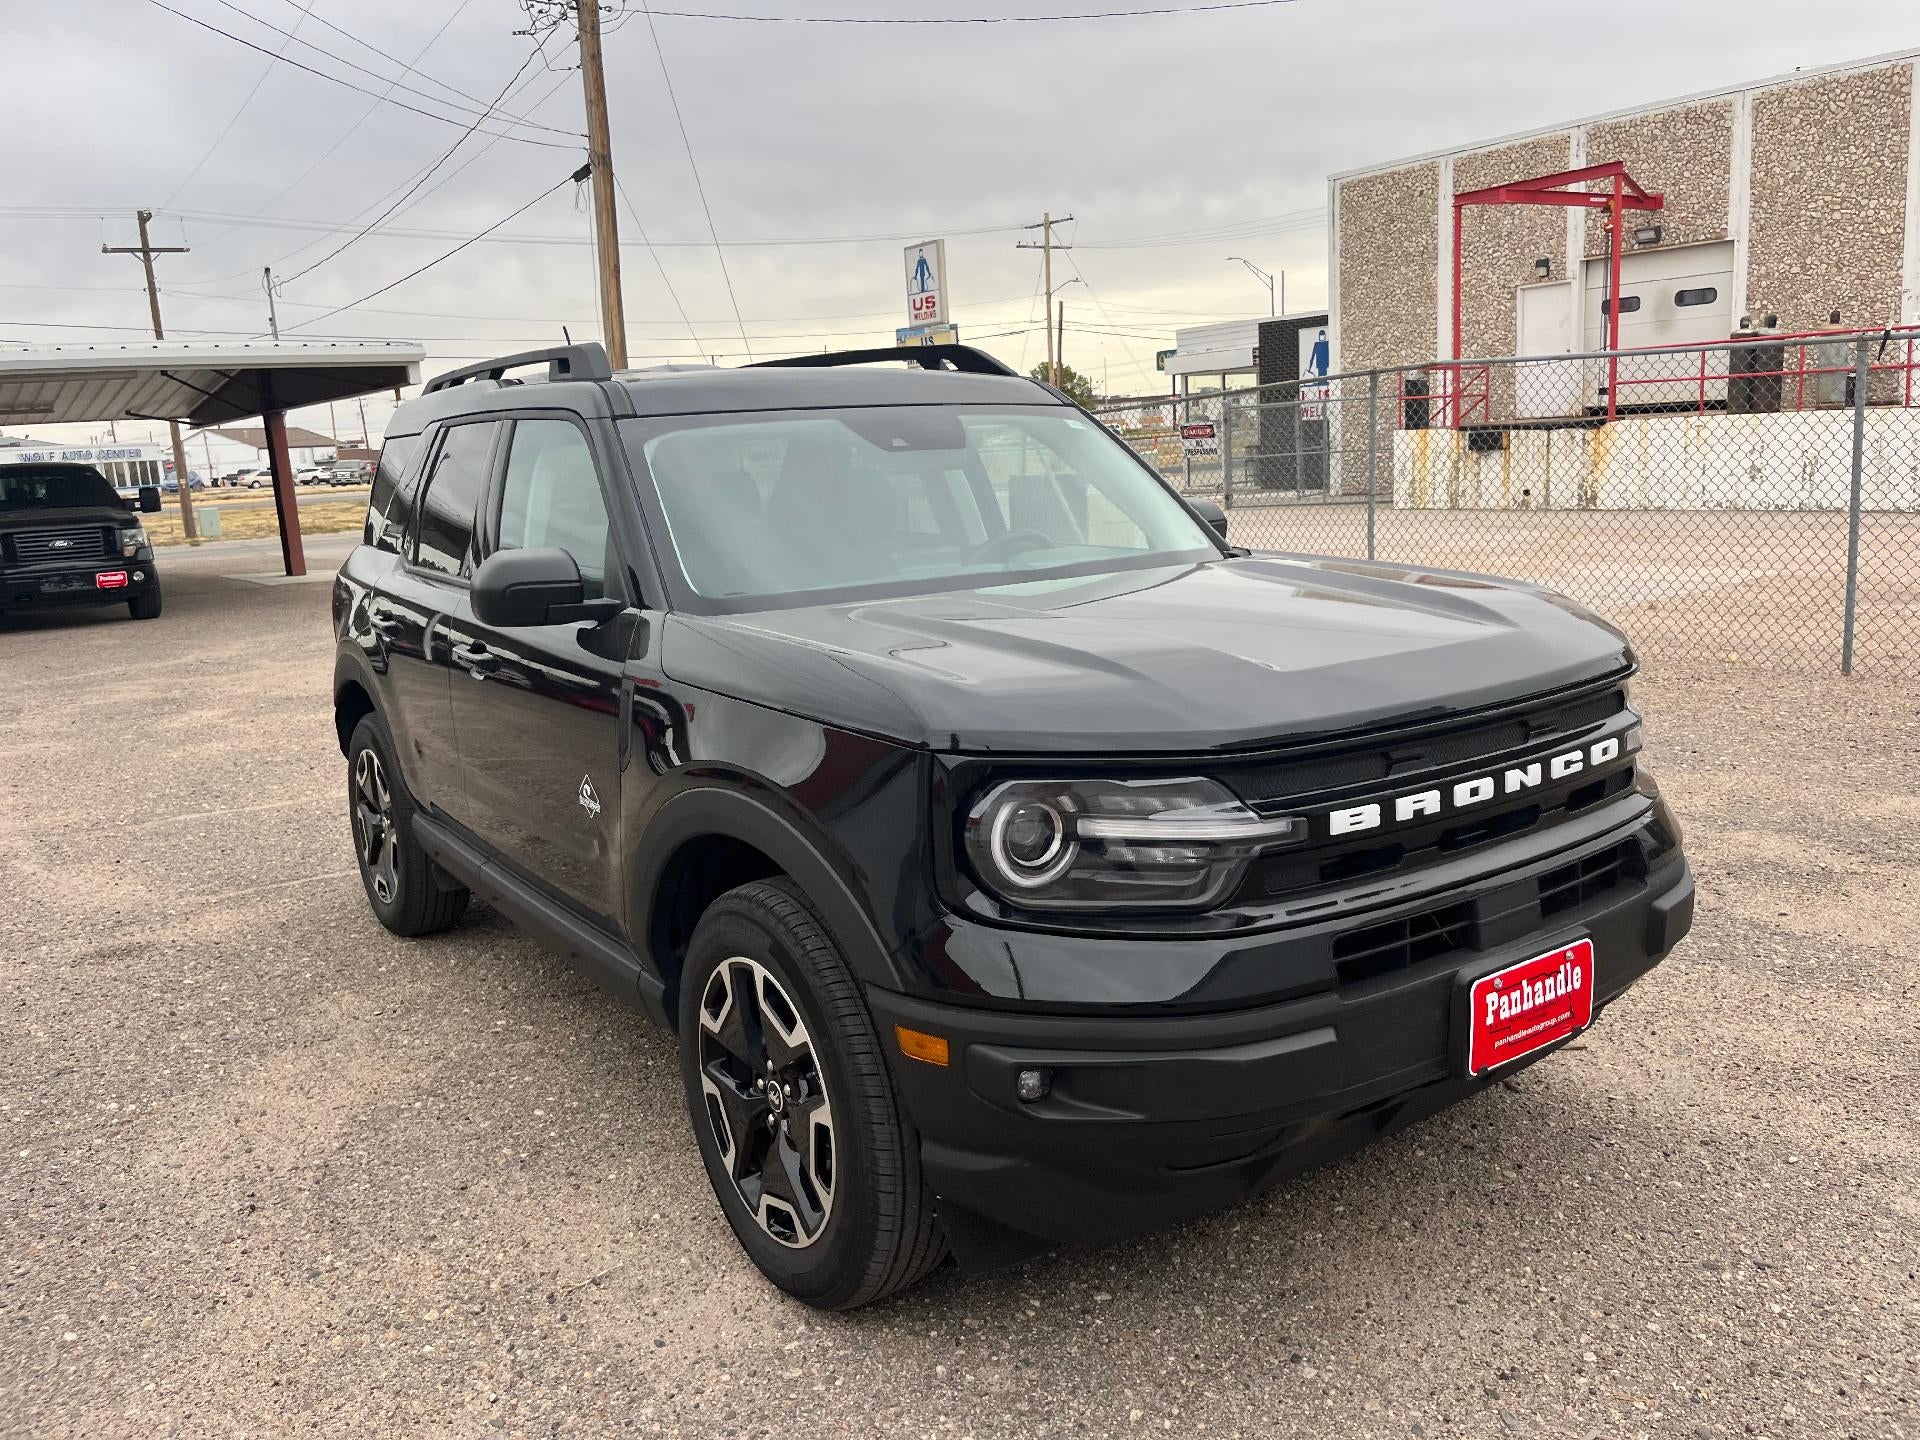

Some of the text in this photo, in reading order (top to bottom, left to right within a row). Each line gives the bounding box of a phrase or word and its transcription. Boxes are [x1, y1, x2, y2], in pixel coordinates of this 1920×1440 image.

[913, 296, 936, 311] US
[914, 310, 937, 320] WELDING
[1183, 428, 1211, 436] DANGER
[20, 448, 142, 463] WOLF AUTO CENTER
[1184, 448, 1218, 456] TRESPASSING
[1329, 737, 1619, 836] BRONCO
[1485, 961, 1582, 1026] Panhandle
[1494, 1010, 1572, 1050] panhandleautogroup.com
